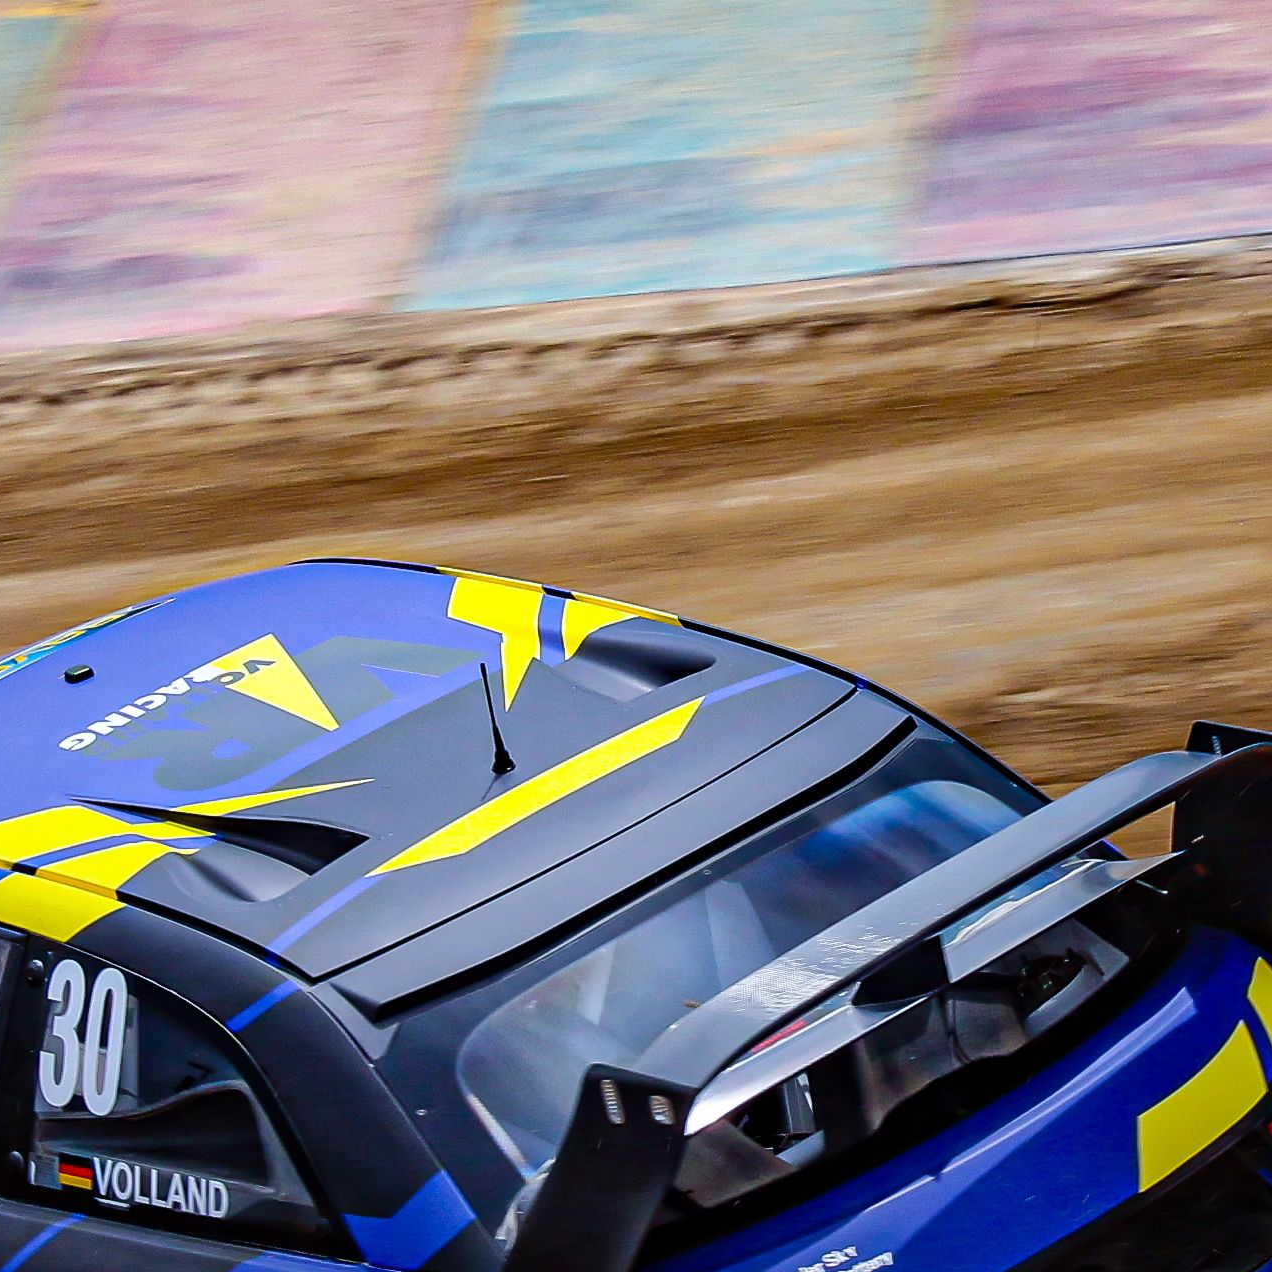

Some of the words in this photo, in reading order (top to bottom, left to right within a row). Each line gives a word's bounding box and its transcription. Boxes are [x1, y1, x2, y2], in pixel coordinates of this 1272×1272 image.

[58, 664, 223, 751] RACING
[39, 958, 128, 1116] 30
[92, 1156, 230, 1218] VOLLAND
